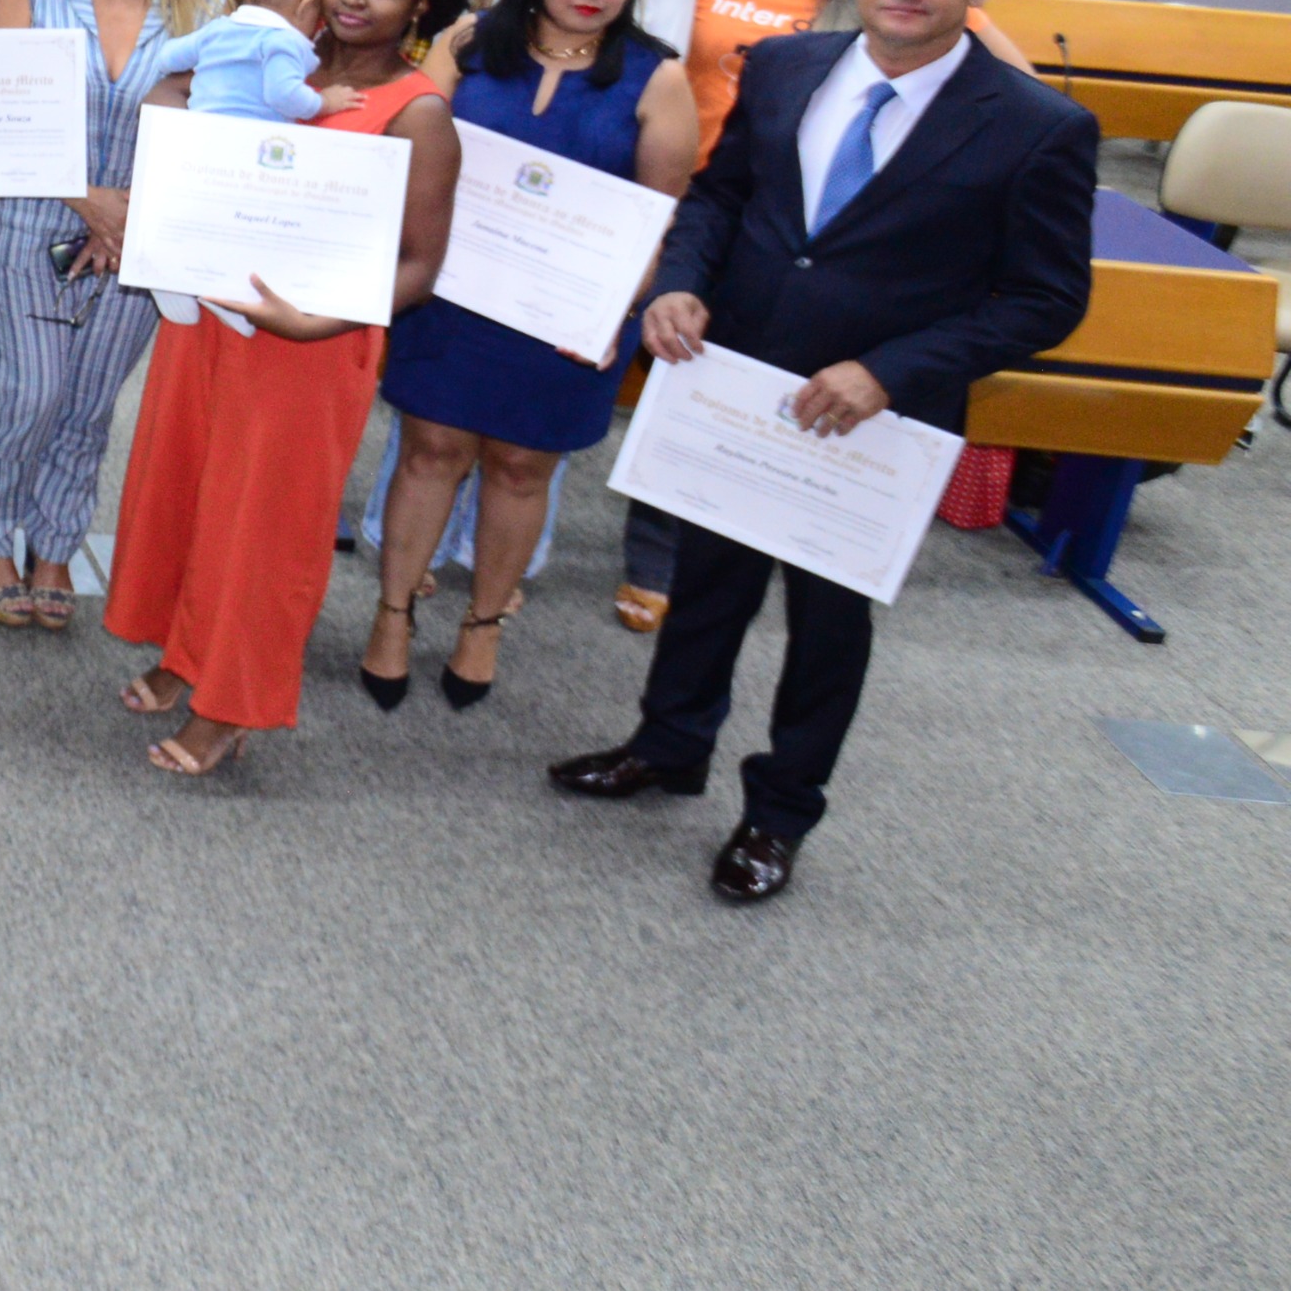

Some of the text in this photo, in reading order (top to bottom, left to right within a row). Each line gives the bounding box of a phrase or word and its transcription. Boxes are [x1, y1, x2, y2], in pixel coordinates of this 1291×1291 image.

[0, 77, 10, 86] ao
[15, 75, 53, 85] Mérito
[234, 211, 300, 229] Raquel Lopes
